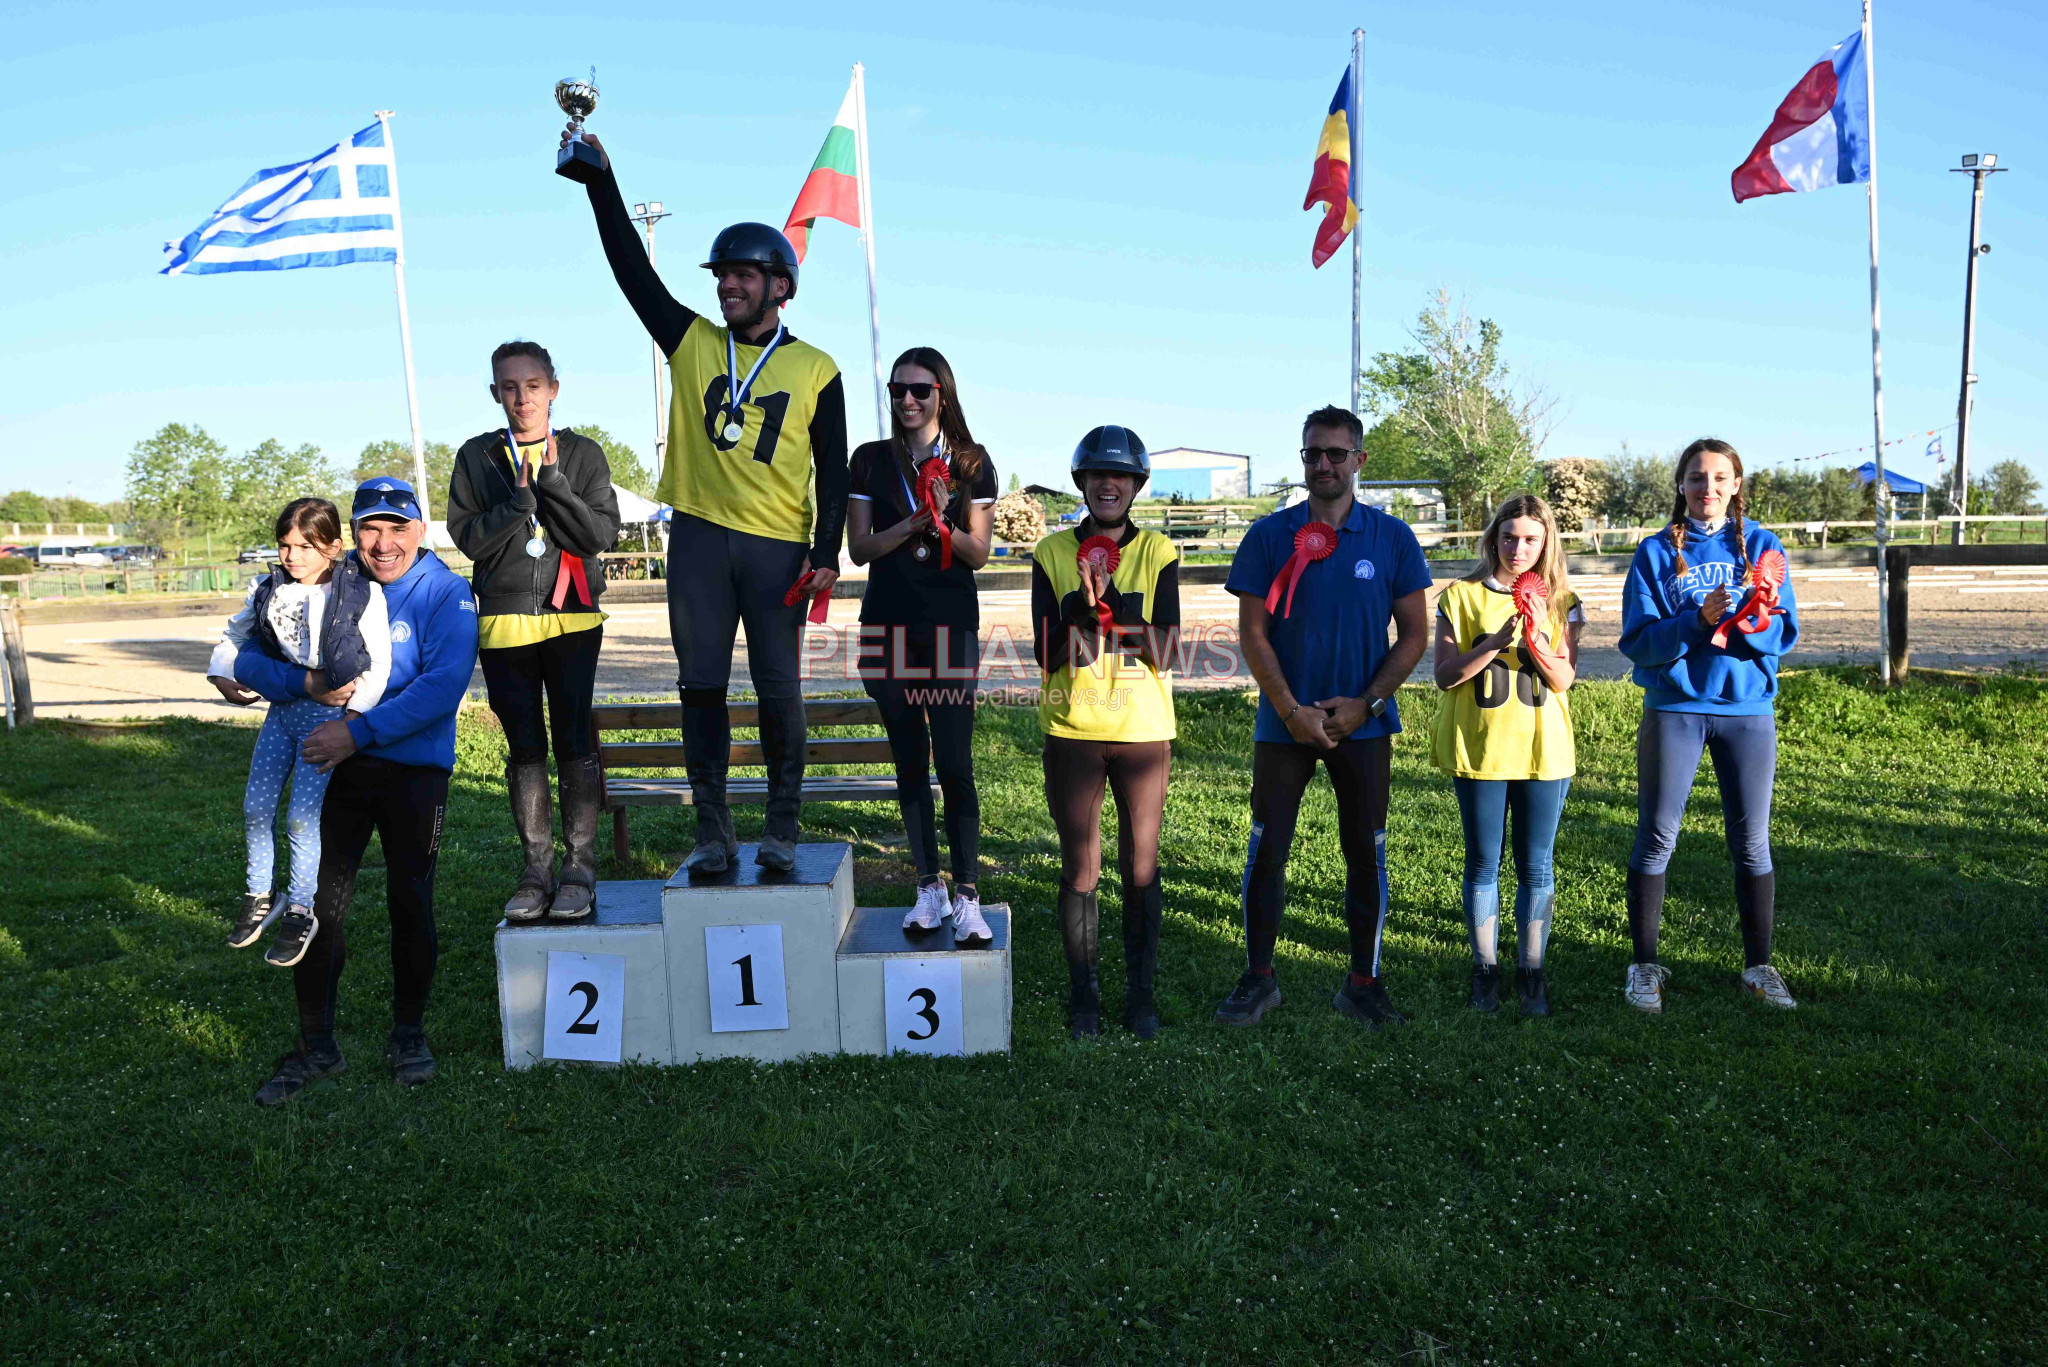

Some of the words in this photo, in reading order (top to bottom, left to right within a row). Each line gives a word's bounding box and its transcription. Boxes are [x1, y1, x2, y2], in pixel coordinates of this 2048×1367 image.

[703, 374, 792, 466] 61
[432, 805, 443, 852] PODIUM
[731, 953, 763, 1006] 1
[565, 981, 600, 1035] 2
[906, 987, 941, 1041] 3
